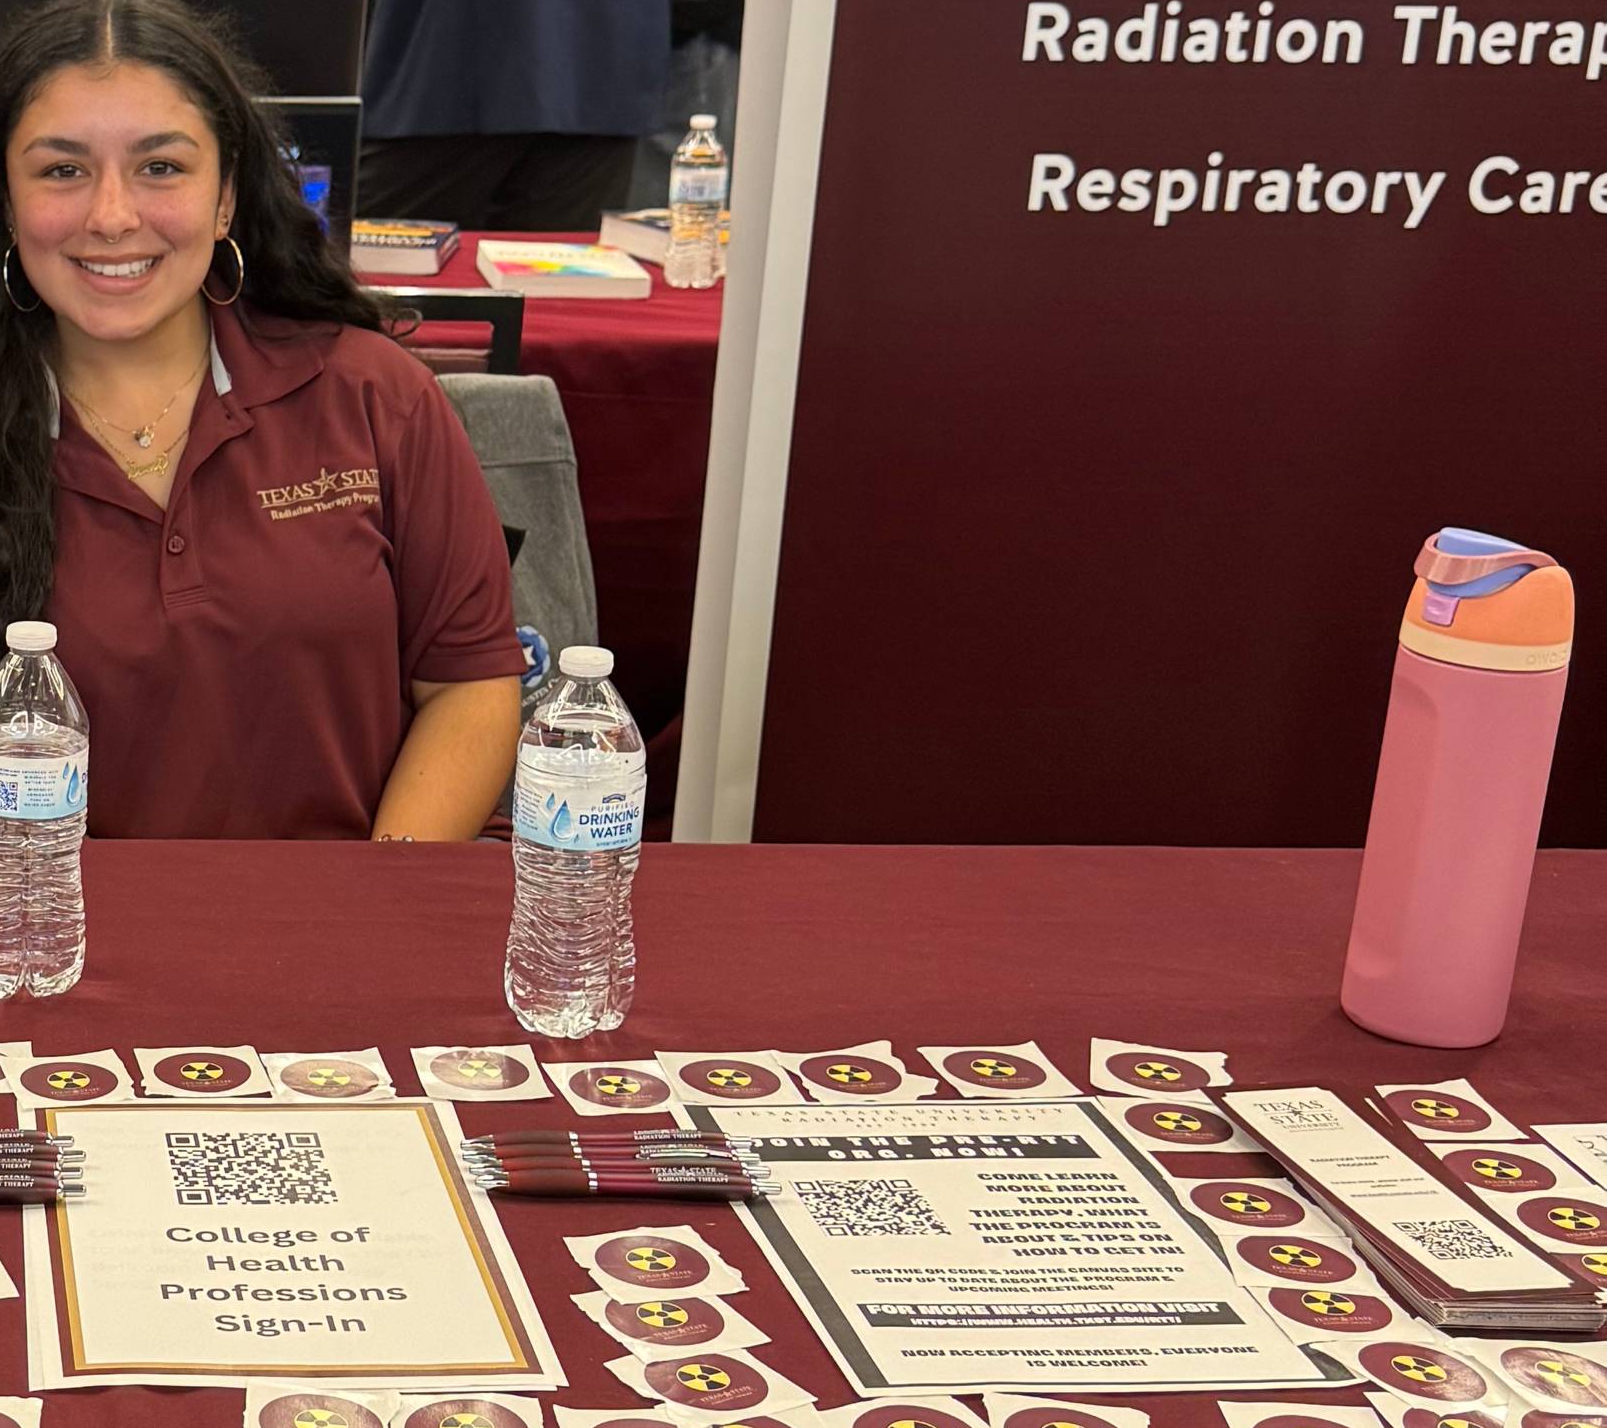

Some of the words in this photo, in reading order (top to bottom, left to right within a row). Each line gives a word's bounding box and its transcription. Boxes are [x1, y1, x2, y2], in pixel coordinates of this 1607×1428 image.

[1022, 0, 1364, 64] Radiation
[1027, 151, 1447, 229] Respiratory
[257, 484, 315, 506] TEXAS
[271, 506, 314, 521] Radiation
[315, 496, 353, 513] Therapy
[579, 806, 640, 825] DRINKING
[590, 823, 633, 838] WATER
[1253, 1100, 1324, 1112] TEXAS
[1270, 1113, 1336, 1125] STATE
[753, 1137, 831, 1148] JOIN
[847, 1136, 913, 1147] THE
[927, 1134, 1080, 1146] PRE-RTT
[828, 1149, 914, 1160] ORG.
[930, 1147, 1025, 1159] NOW!
[969, 1222, 1014, 1231] THE
[1137, 1221, 1162, 1229] IS
[165, 1226, 318, 1248] College
[330, 1226, 371, 1243] of
[982, 1235, 1057, 1243] ABOUT
[1082, 1234, 1135, 1242] TIPS
[1012, 1248, 1068, 1257] HOW
[1070, 1247, 1100, 1255] TO
[206, 1254, 345, 1272] Health
[160, 1283, 408, 1302] Professions
[866, 1304, 917, 1315] FOR
[917, 1305, 991, 1315] MORE
[991, 1303, 1156, 1315] INFORMATION
[1157, 1303, 1220, 1313] VISIT
[214, 1314, 367, 1338] Sign-In
